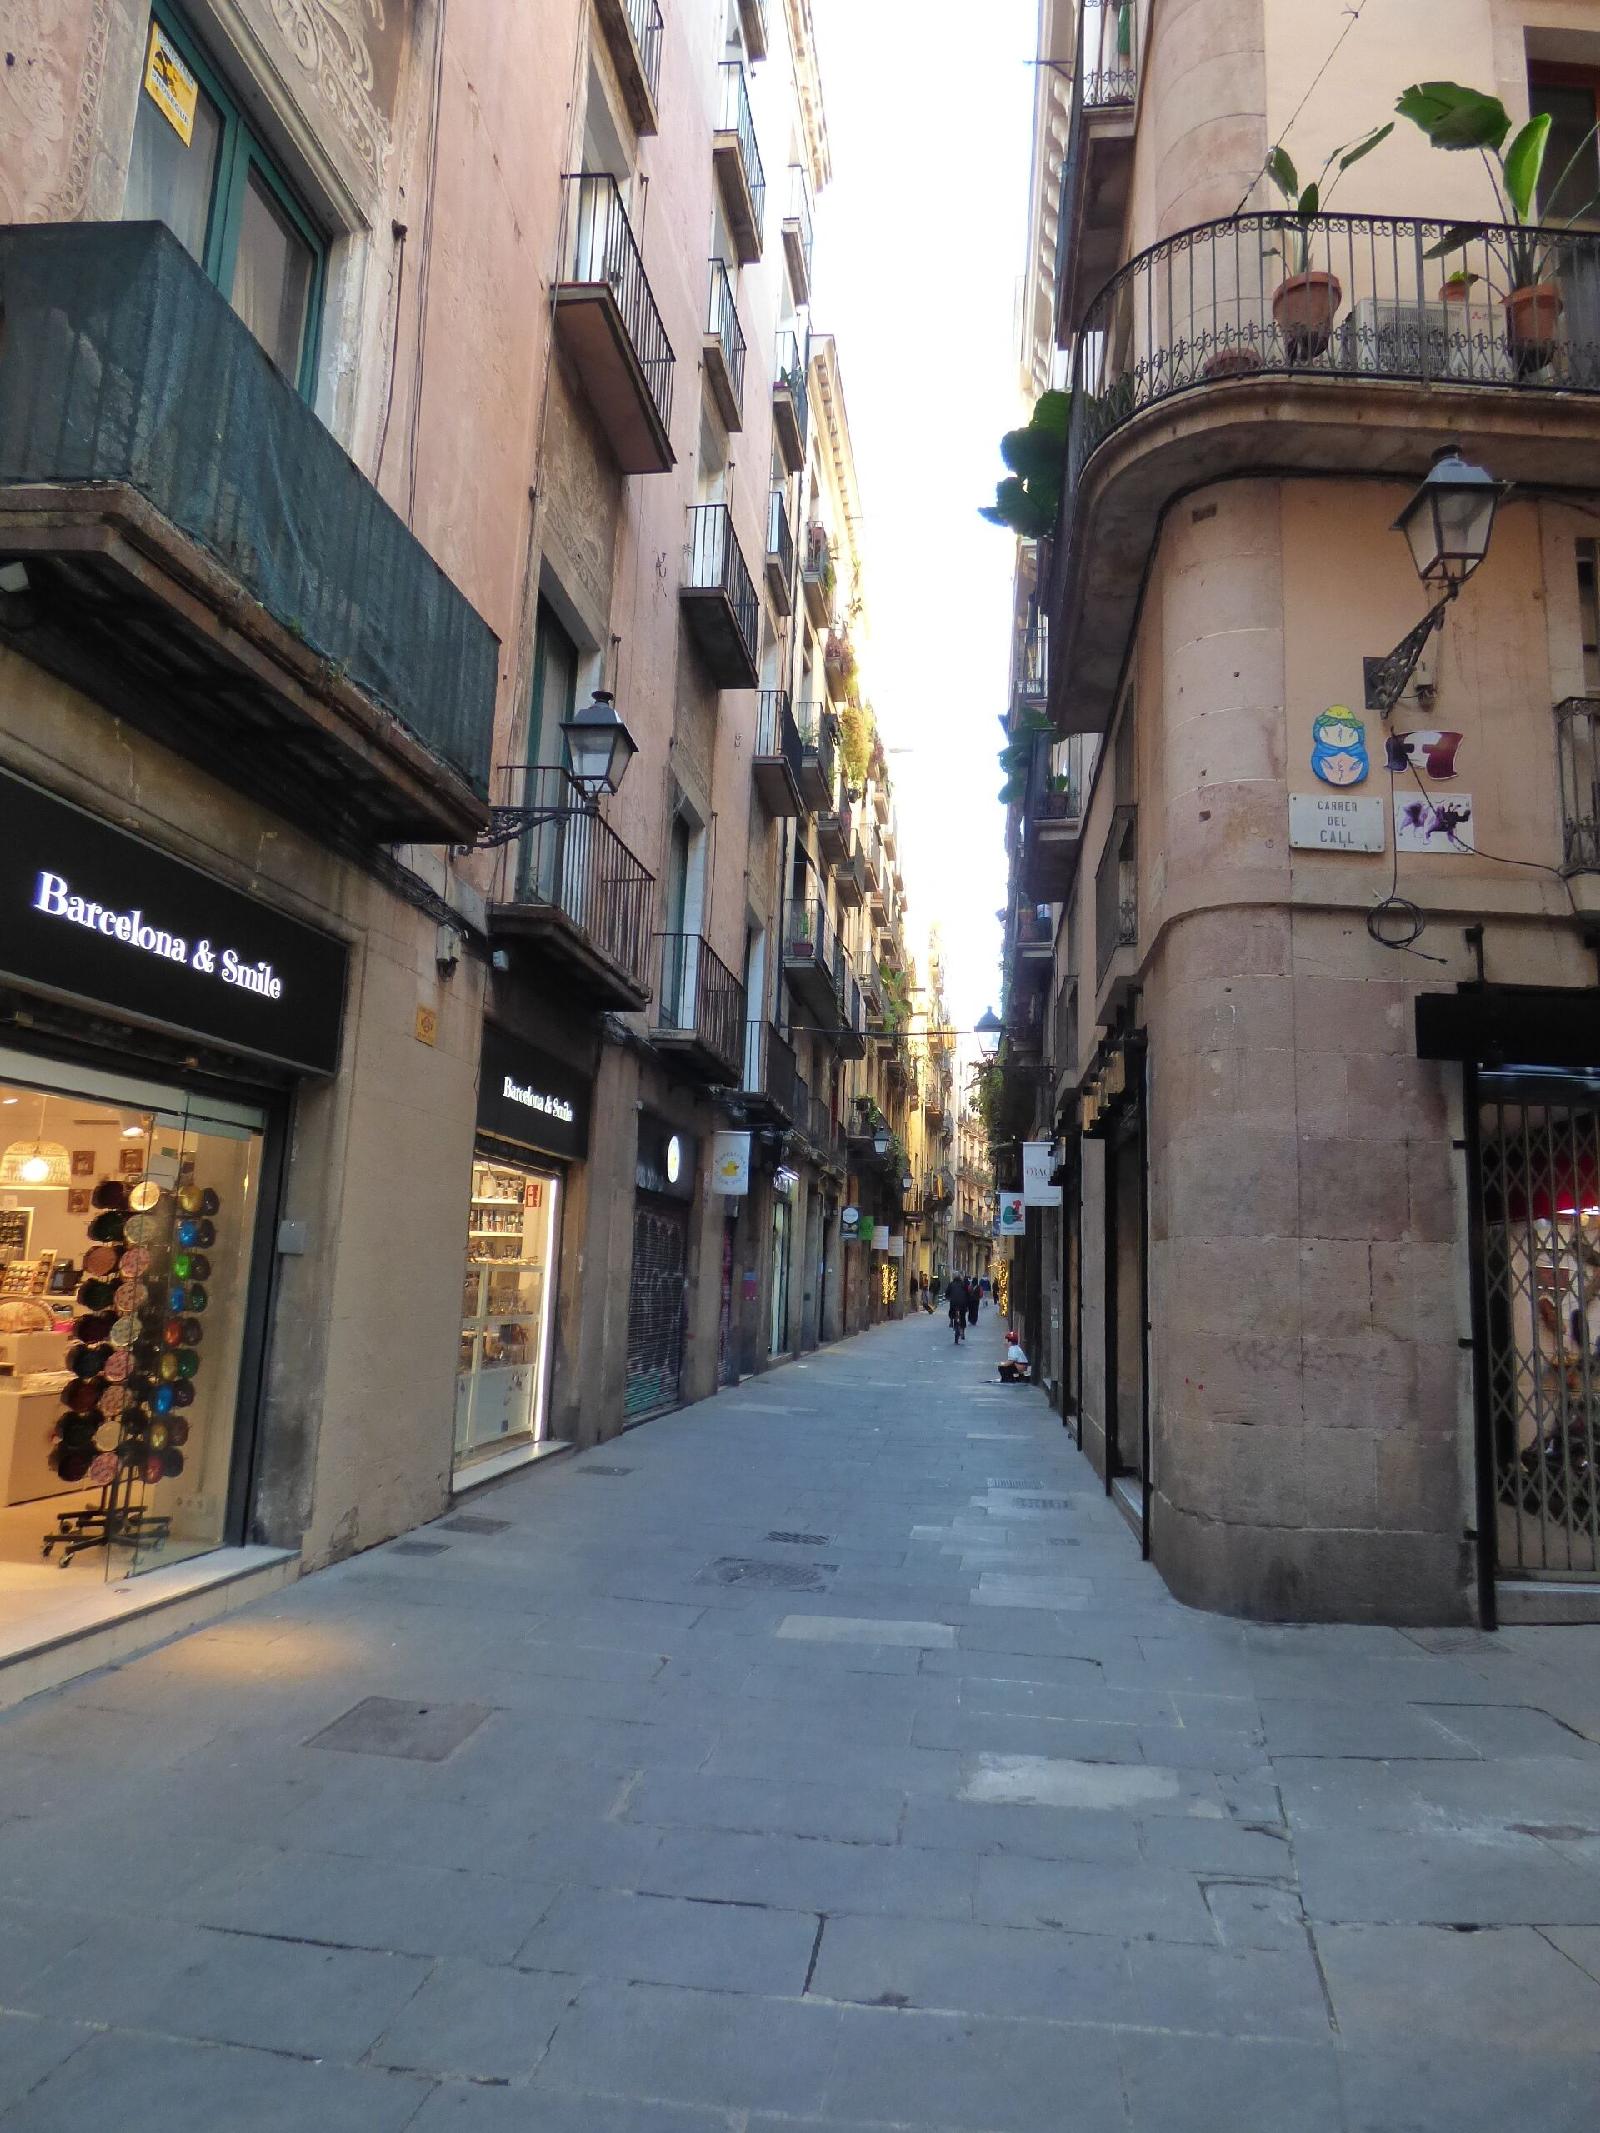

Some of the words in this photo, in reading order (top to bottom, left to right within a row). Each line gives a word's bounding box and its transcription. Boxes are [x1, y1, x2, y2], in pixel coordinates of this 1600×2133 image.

[1317, 800, 1358, 813] CARRER
[1327, 816, 1347, 828] DEL
[1320, 829, 1355, 844] CALL
[34, 871, 188, 964] Barcelona
[192, 939, 215, 973] &
[221, 950, 281, 999] Smile
[503, 1076, 544, 1112] Barcelona
[544, 1095, 552, 1114] &
[552, 1097, 573, 1122] Smile
